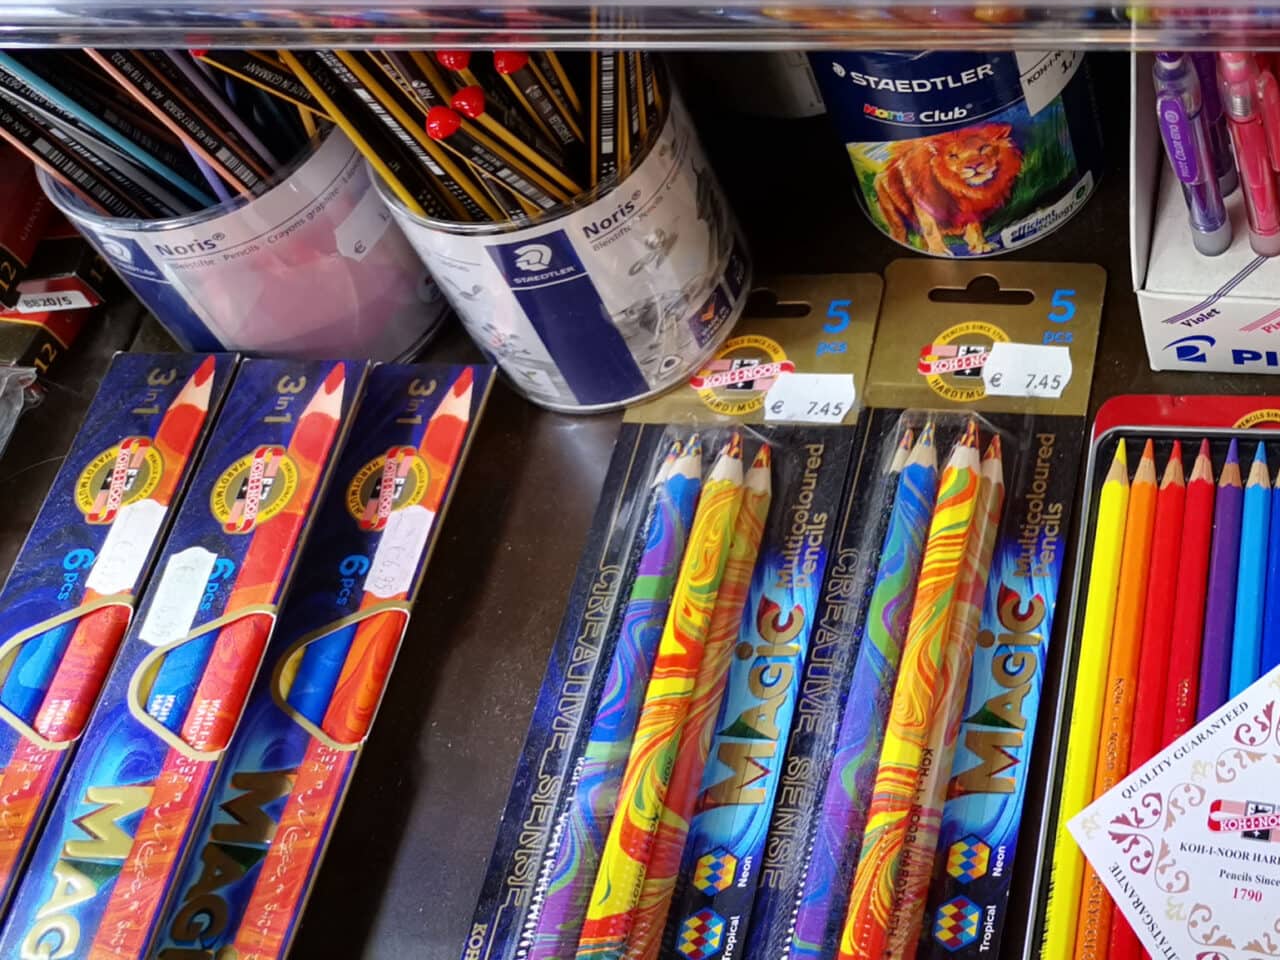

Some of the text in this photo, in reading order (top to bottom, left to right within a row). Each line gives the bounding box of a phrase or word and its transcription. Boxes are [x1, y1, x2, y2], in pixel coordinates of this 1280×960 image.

[850, 64, 993, 93] STAEDTLER
[267, 218, 306, 245] Crayons
[1010, 209, 1057, 239] efficient
[512, 265, 577, 285] STAEDTLER
[823, 299, 852, 334] 5
[1047, 289, 1076, 323] 5
[1181, 307, 1220, 330] Violet
[816, 342, 848, 357] pcs
[1043, 330, 1073, 345] pcs
[132, 368, 178, 415] 3 1
[703, 362, 782, 387] KOH-I-NOOR
[990, 373, 1062, 390] € 7.45
[264, 376, 306, 425] 3 1
[395, 378, 437, 425] 3 1
[771, 400, 844, 417] € 7.45
[1237, 411, 1265, 429] PENCILS
[107, 447, 129, 510] KOH-I-NOOR
[244, 456, 263, 520] KOH-I-NOOR
[377, 456, 396, 518] KOH-I-NOOR
[777, 443, 825, 589] Multicoloured
[1013, 432, 1056, 577] Multicoloured
[799, 511, 828, 588] Pencils
[1034, 501, 1064, 577] Pencils
[56, 547, 96, 601] 6 pcs
[336, 554, 370, 607] 6 pcs
[200, 580, 220, 611] pcs
[547, 562, 622, 751] CREATIVE
[760, 548, 860, 890] CREATIVE SENSE
[1121, 701, 1250, 800] QUALITY GUARANTEED
[506, 773, 562, 907] SENSE
[1179, 843, 1249, 862] KOH-I-NOOR
[737, 856, 752, 887] Neon
[991, 845, 1005, 878] Neon
[1219, 869, 1280, 888] Pencils Since
[1232, 887, 1263, 904] 1790
[721, 915, 740, 960] Tropical
[979, 904, 998, 953] Tropical
